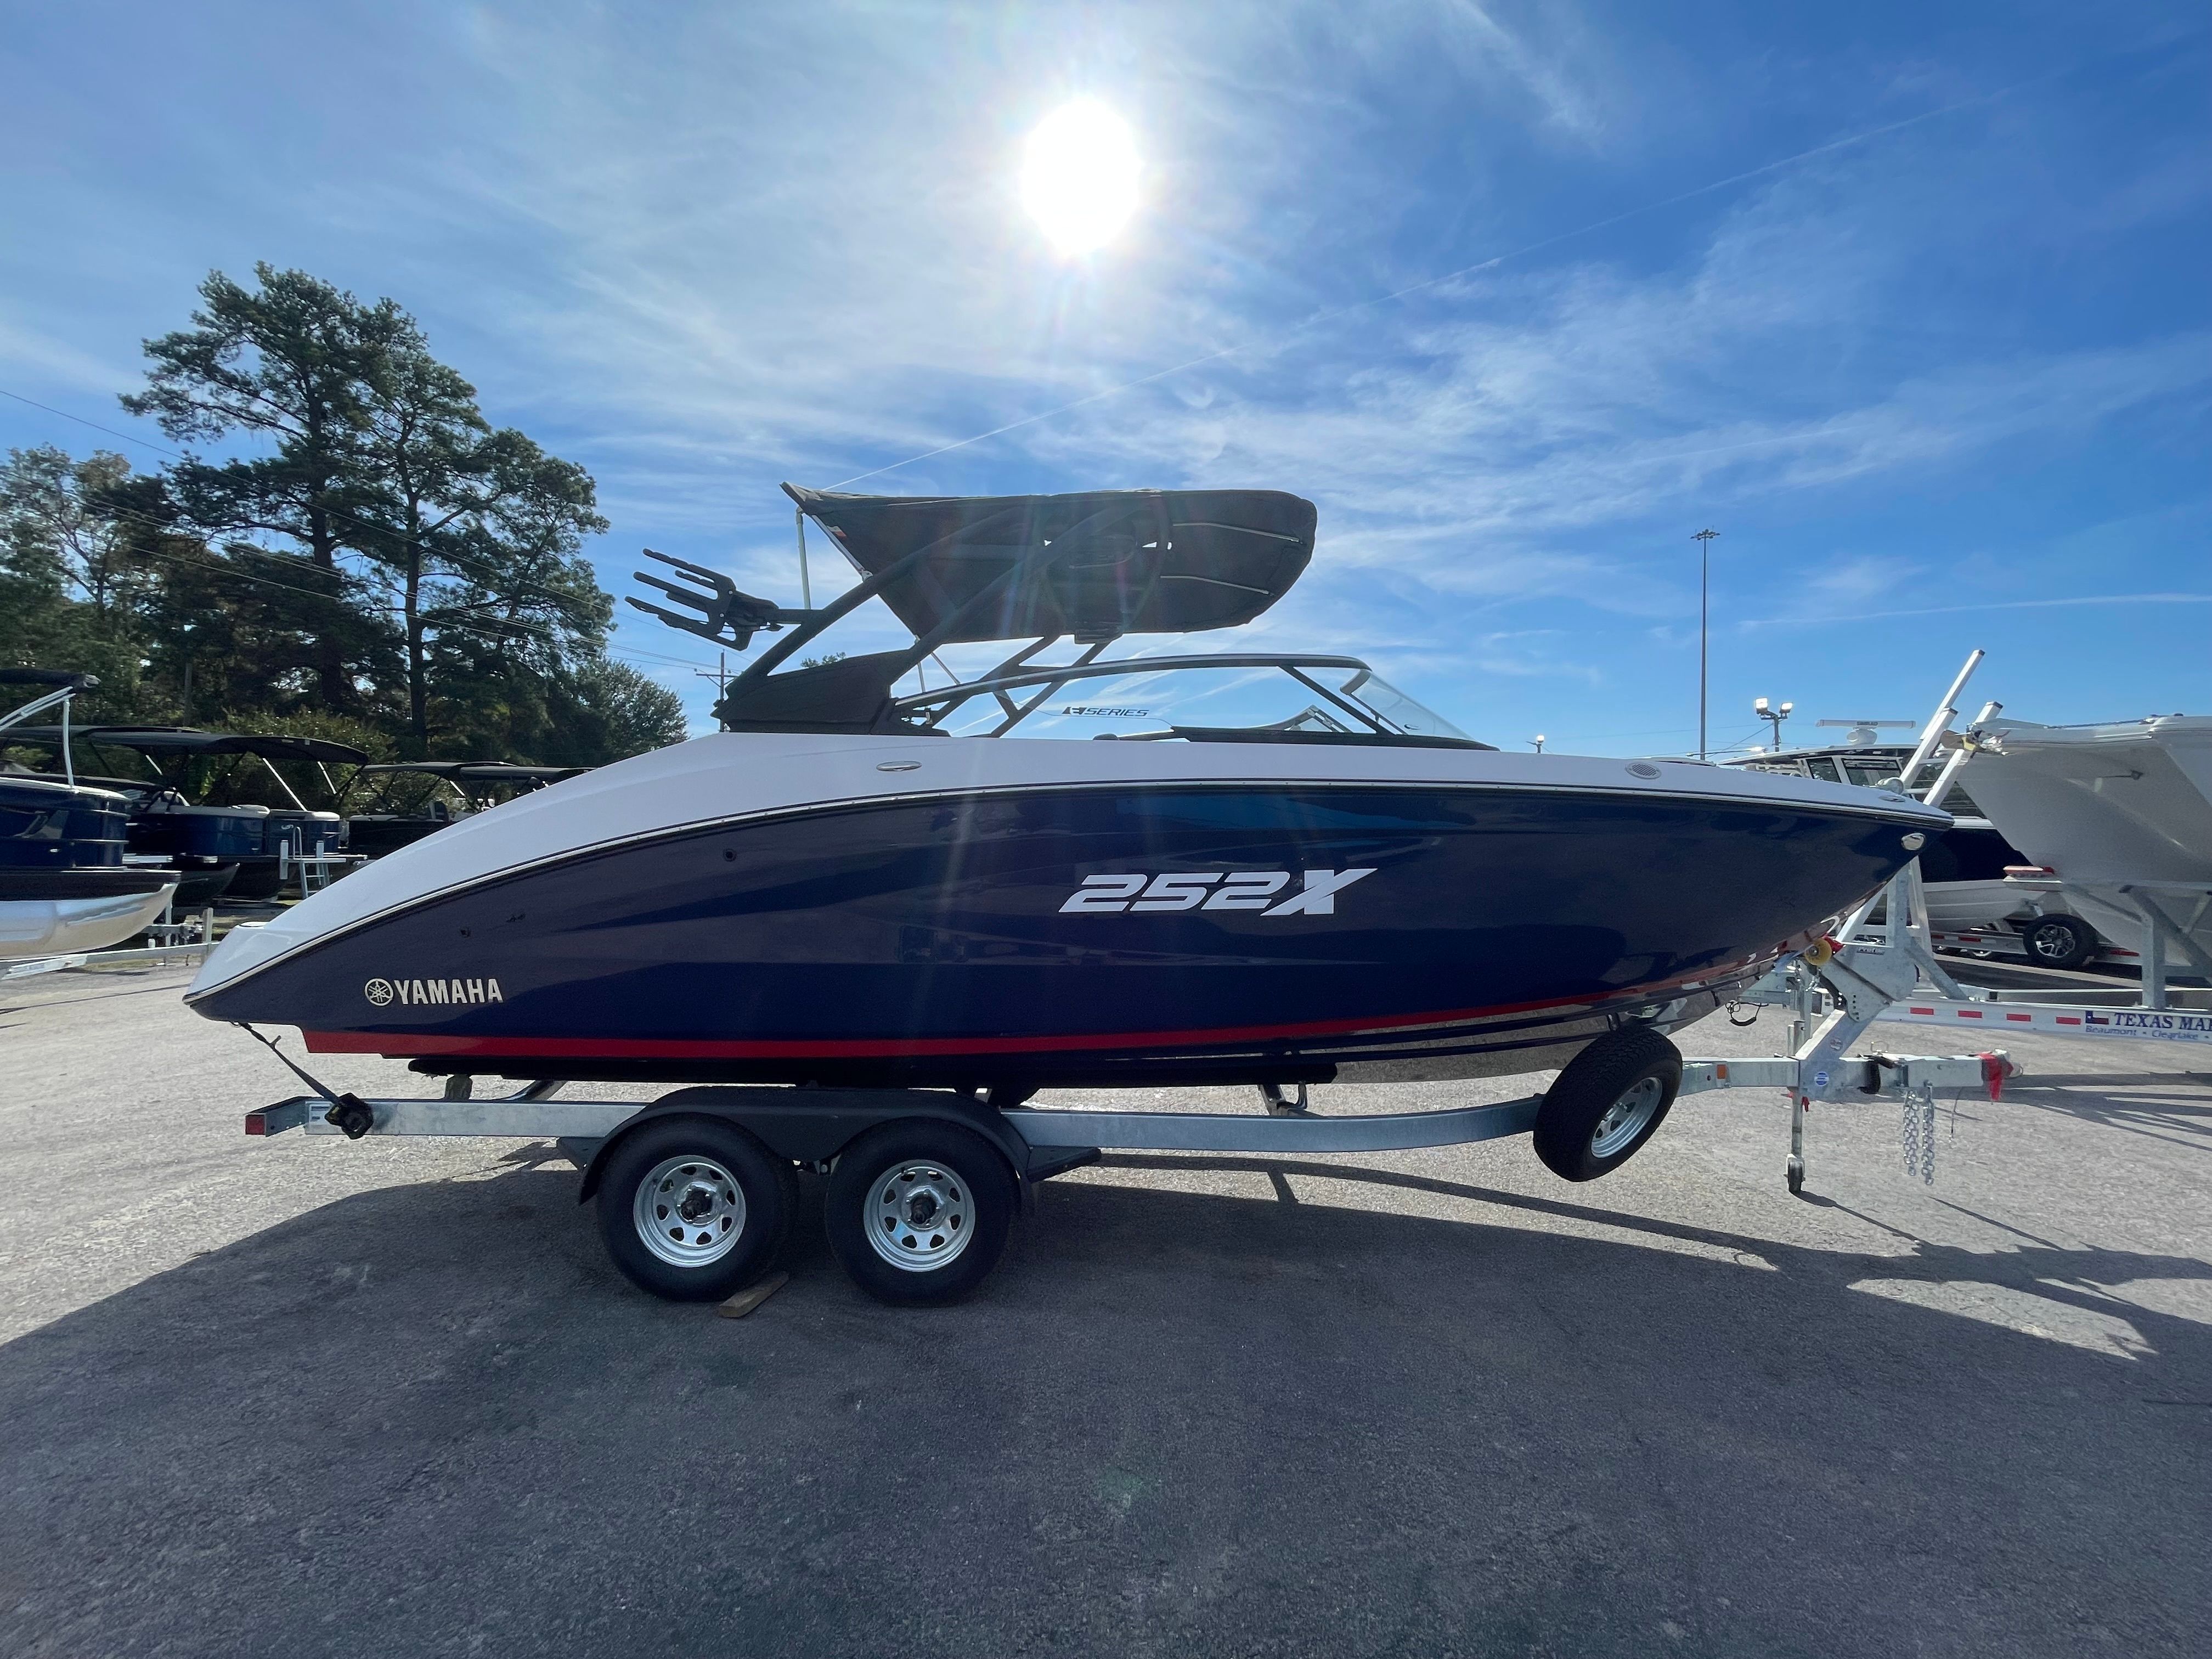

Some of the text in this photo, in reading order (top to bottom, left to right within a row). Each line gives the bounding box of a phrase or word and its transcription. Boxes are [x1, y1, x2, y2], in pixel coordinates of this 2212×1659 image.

[1084, 708, 1149, 716] SERIES
[1058, 868, 1378, 916] 252X
[393, 978, 504, 1005] YAMAHA
[2086, 1025, 2137, 1036] Beaumont
[2114, 1012, 2212, 1031] TEXAS MA
